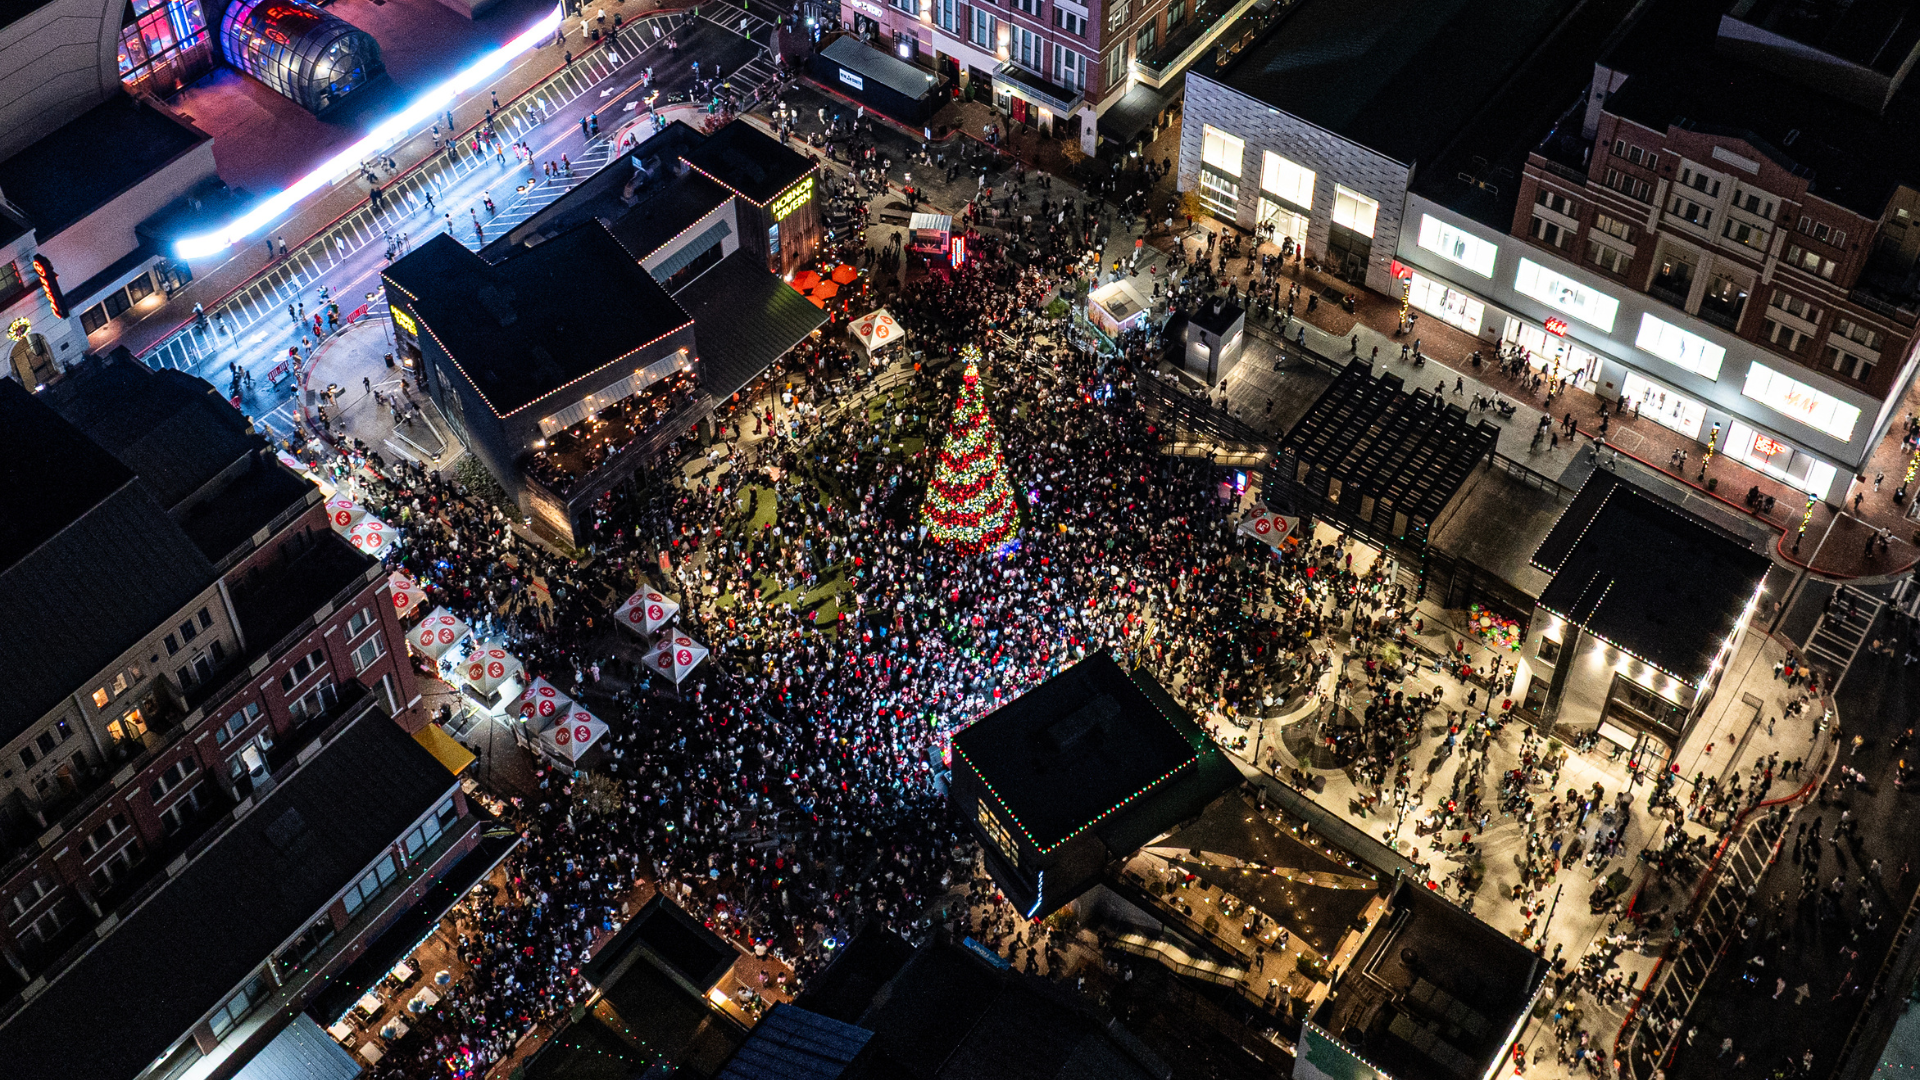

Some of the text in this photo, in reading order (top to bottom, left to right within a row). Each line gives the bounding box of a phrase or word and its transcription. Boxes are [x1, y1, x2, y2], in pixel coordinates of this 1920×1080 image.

[772, 177, 813, 213] HOBNOB
[776, 189, 811, 221] TAVERN
[1546, 320, 1568, 337] H&M
